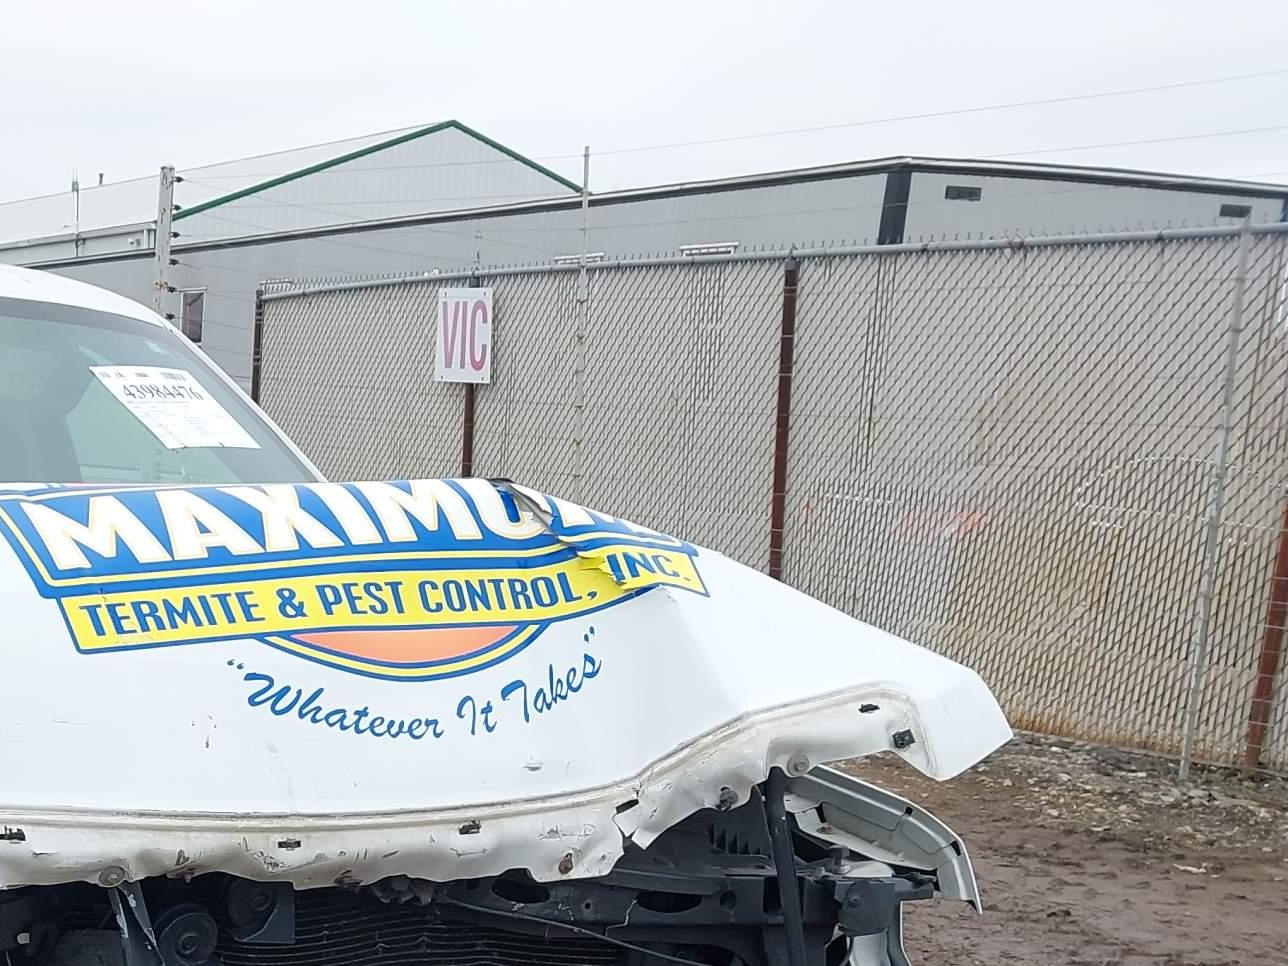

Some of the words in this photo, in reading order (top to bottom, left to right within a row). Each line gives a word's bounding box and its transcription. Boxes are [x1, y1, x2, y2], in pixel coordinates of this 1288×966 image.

[442, 299, 488, 371] VIC
[123, 383, 204, 400] 43984476
[79, 588, 265, 638] TERMITE
[278, 585, 308, 620] &
[324, 579, 405, 618] PEST
[420, 571, 599, 612] CONTROL,
[606, 552, 691, 584] INC.
[456, 696, 498, 735] It
